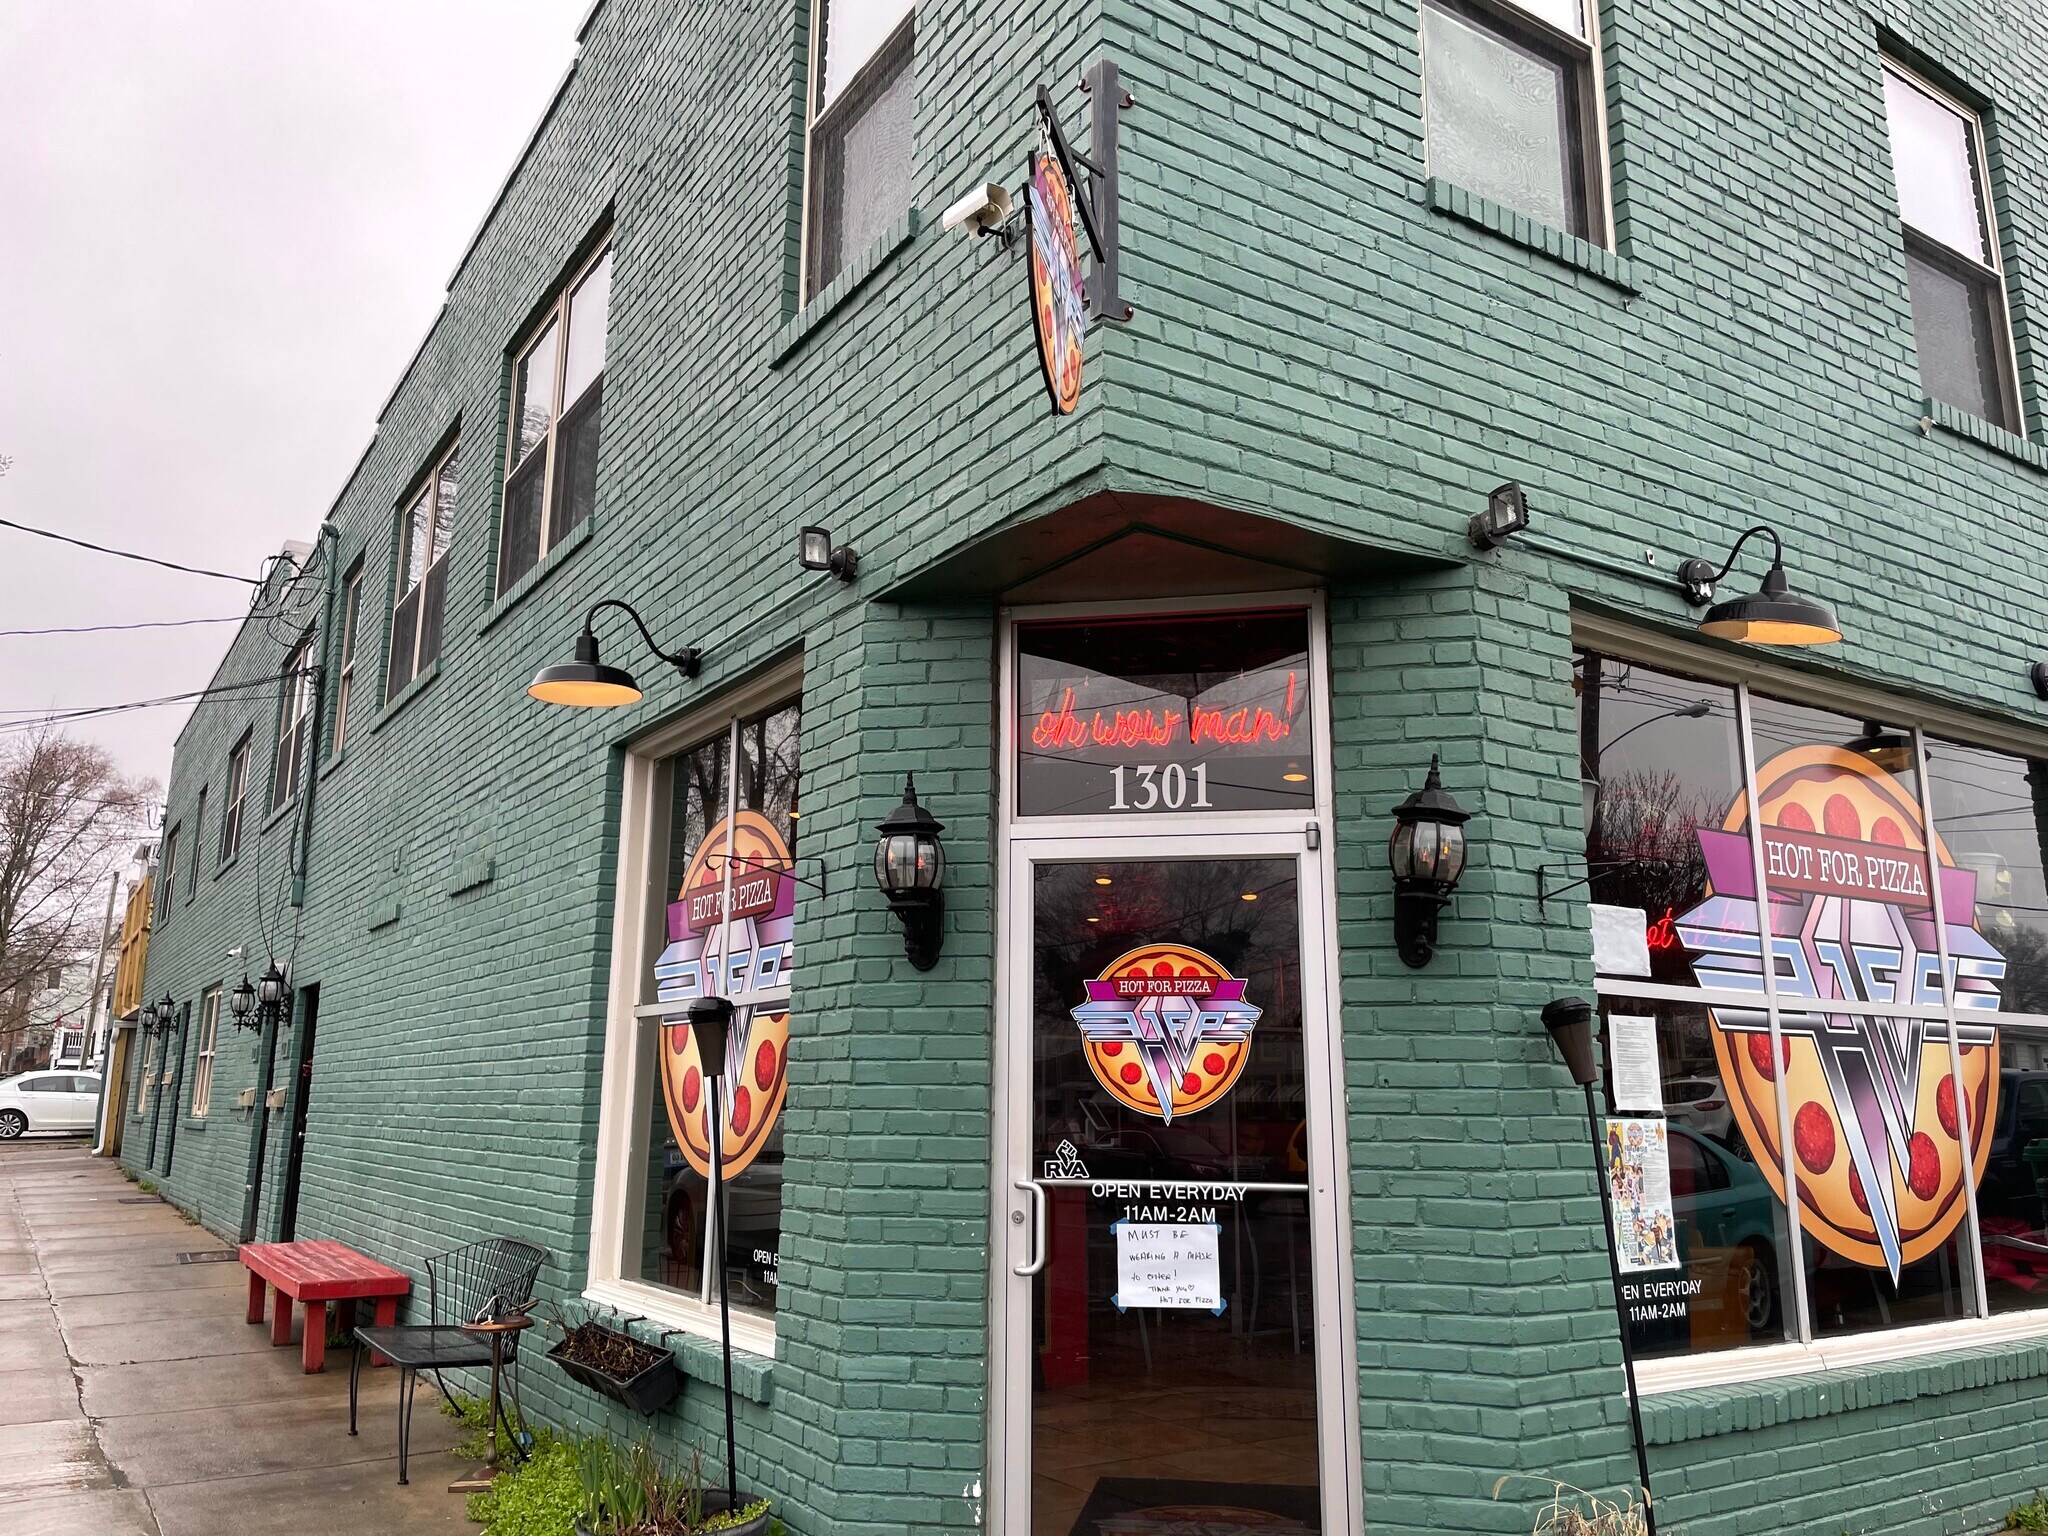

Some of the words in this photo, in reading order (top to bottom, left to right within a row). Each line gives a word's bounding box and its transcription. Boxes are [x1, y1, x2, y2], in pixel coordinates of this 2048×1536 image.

[1032, 687, 1088, 749] oh
[1092, 707, 1182, 747] wow
[1190, 671, 1296, 745] man!
[1108, 762, 1213, 810] 1301
[1766, 840, 1813, 880] HOT
[1817, 848, 1863, 887] FOR
[1864, 856, 1928, 897] PIZZA
[691, 894, 714, 921] HOT
[737, 878, 773, 910] PIZZA
[1118, 980, 1145, 993] HOT
[1146, 980, 1172, 993] FOR
[1174, 980, 1212, 993] PIZZA
[1044, 1160, 1090, 1179] RVA
[1091, 1182, 1141, 1199] OPEN
[1149, 1184, 1248, 1202] EVERYDAY
[1123, 1205, 1216, 1223] 11AM-2AM
[1127, 1229, 1160, 1242] MUST
[1172, 1230, 1190, 1239] BE
[753, 1248, 772, 1266] OPEN
[1128, 1251, 1166, 1262] WEARING
[1173, 1251, 1180, 1260] A
[1187, 1251, 1213, 1261] MASK
[1621, 1284, 1640, 1300] EN
[1643, 1279, 1702, 1298] EVERYDAY
[1629, 1302, 1687, 1322] 11AM-2AM
